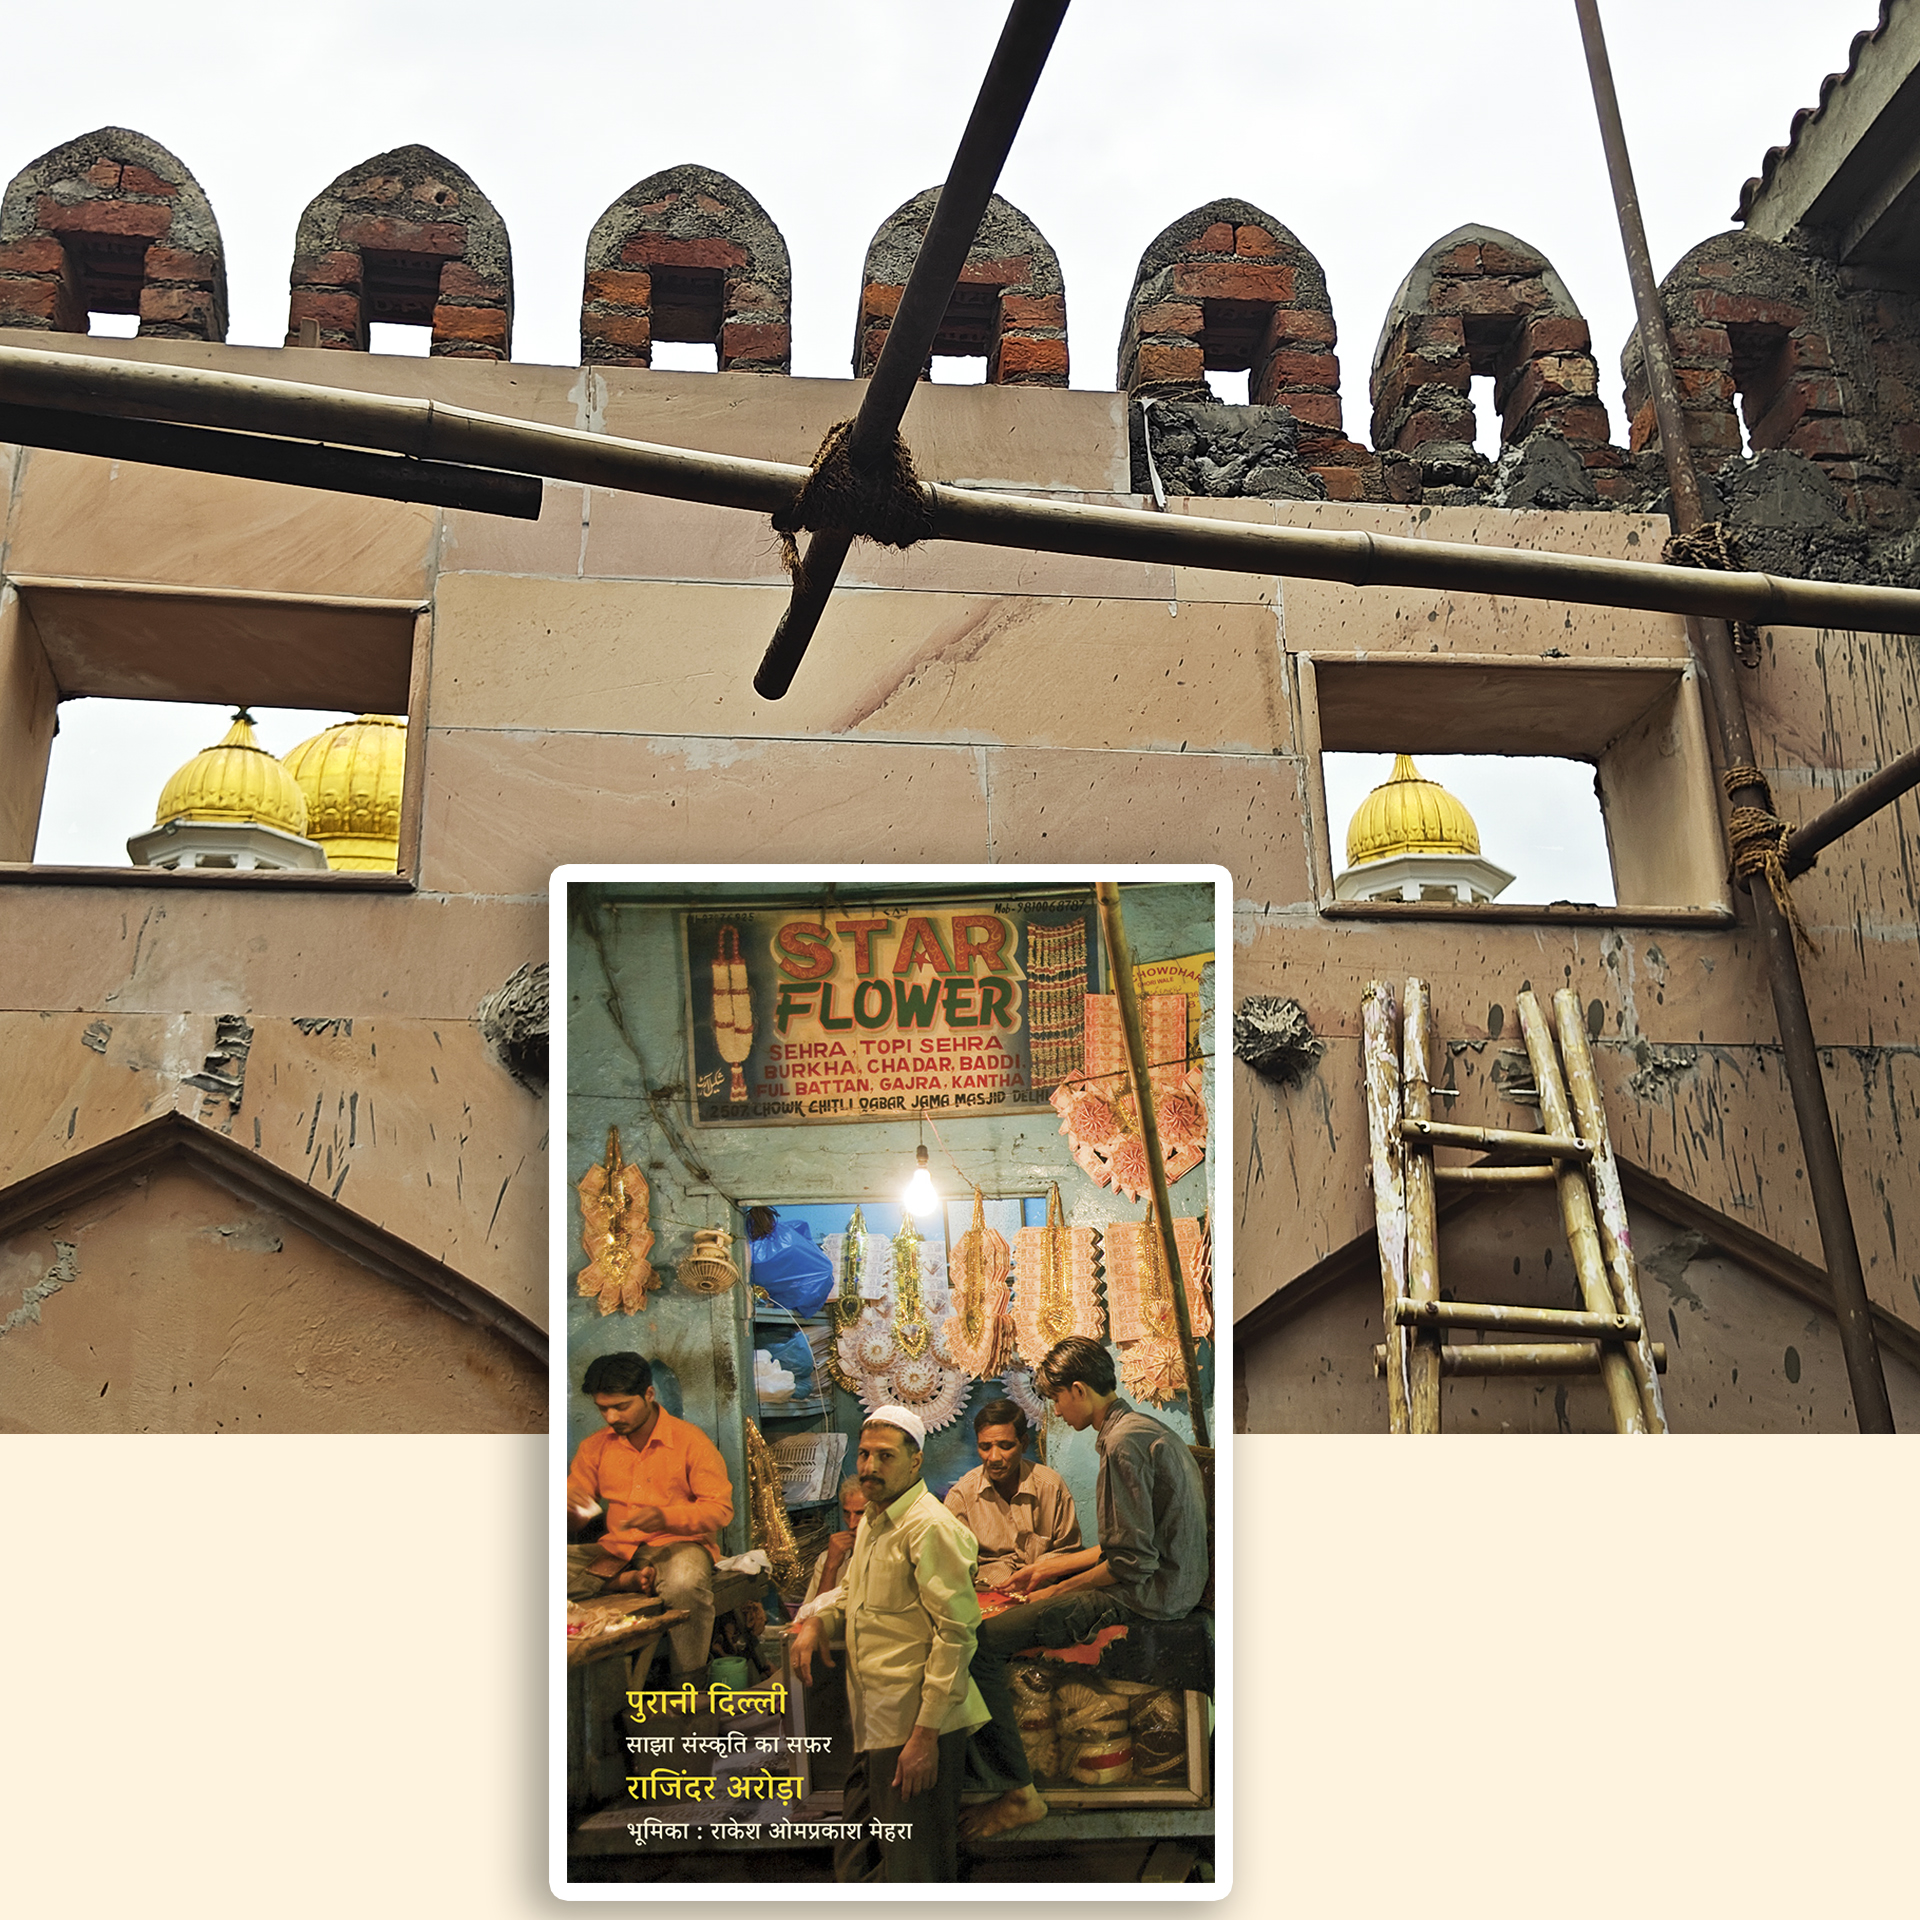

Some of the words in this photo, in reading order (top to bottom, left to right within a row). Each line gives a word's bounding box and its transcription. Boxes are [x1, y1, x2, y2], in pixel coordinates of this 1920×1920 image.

[778, 914, 1009, 981] STAR
[775, 975, 1015, 1035] FLOWER
[860, 1039, 912, 1055] TOPI
[919, 1036, 1004, 1054] SEHRA
[764, 1060, 863, 1079] BURKHA,
[867, 1056, 955, 1074] CHADAR,
[754, 1083, 791, 1098] FUL
[795, 1078, 874, 1097] BATTAN,
[952, 1072, 1026, 1089] KANTHA
[753, 1101, 806, 1118] CHOWK
[808, 1097, 854, 1114] CHITLI
[911, 1093, 951, 1111] JAMA
[954, 1090, 1007, 1107] MASJID
[1012, 1087, 1050, 1105] DELHI
